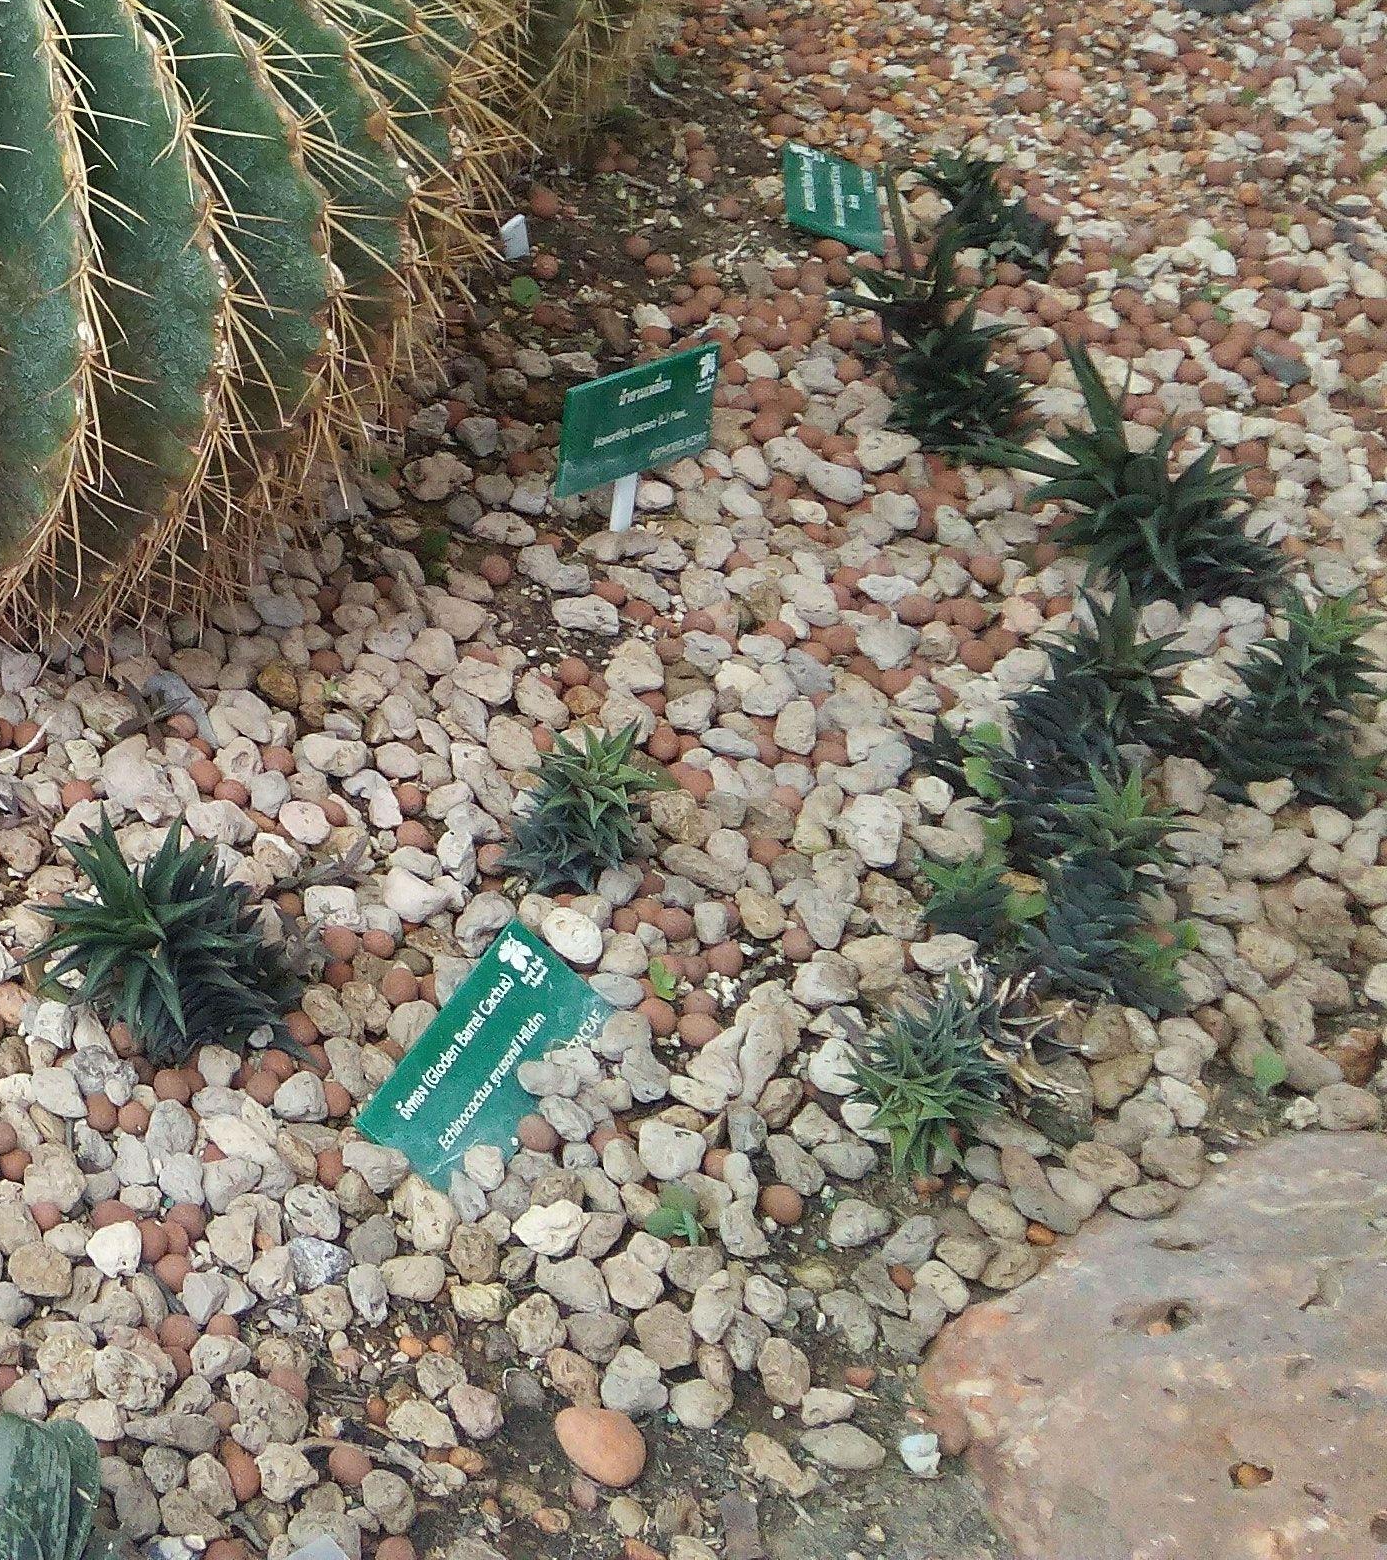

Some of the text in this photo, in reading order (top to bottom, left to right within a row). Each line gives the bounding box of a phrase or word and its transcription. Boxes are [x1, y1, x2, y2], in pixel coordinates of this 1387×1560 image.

[422, 1041, 464, 1090] (Gloden
[454, 1010, 486, 1048] Barrel
[479, 972, 515, 1015] Cactus)
